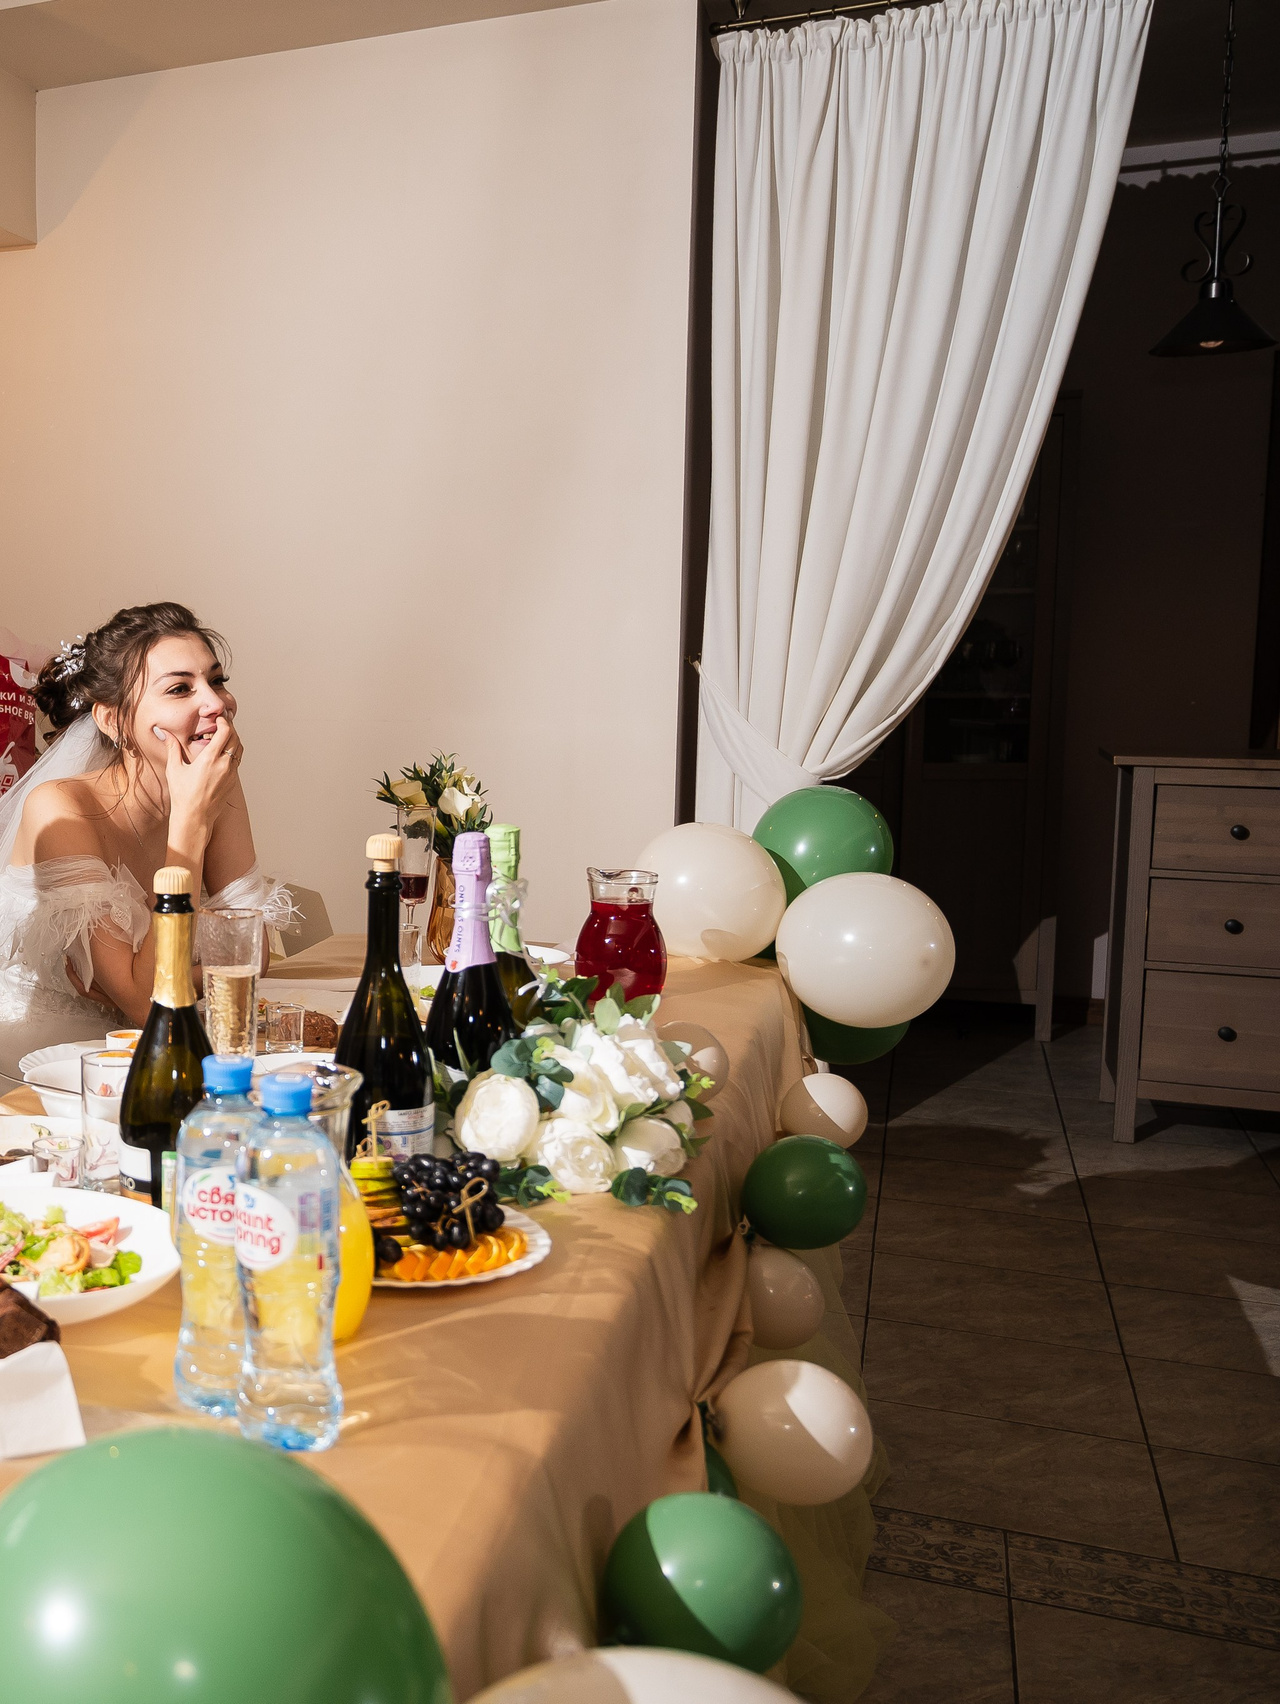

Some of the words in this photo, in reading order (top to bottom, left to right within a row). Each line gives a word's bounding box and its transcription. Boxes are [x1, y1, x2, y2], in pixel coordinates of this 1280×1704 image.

[27, 695, 39, 708] ЗА
[24, 710, 35, 722] ВР
[454, 926, 464, 953] SANTO
[197, 1186, 236, 1206] свя
[187, 1202, 235, 1223] исто
[236, 1225, 282, 1255] pring
